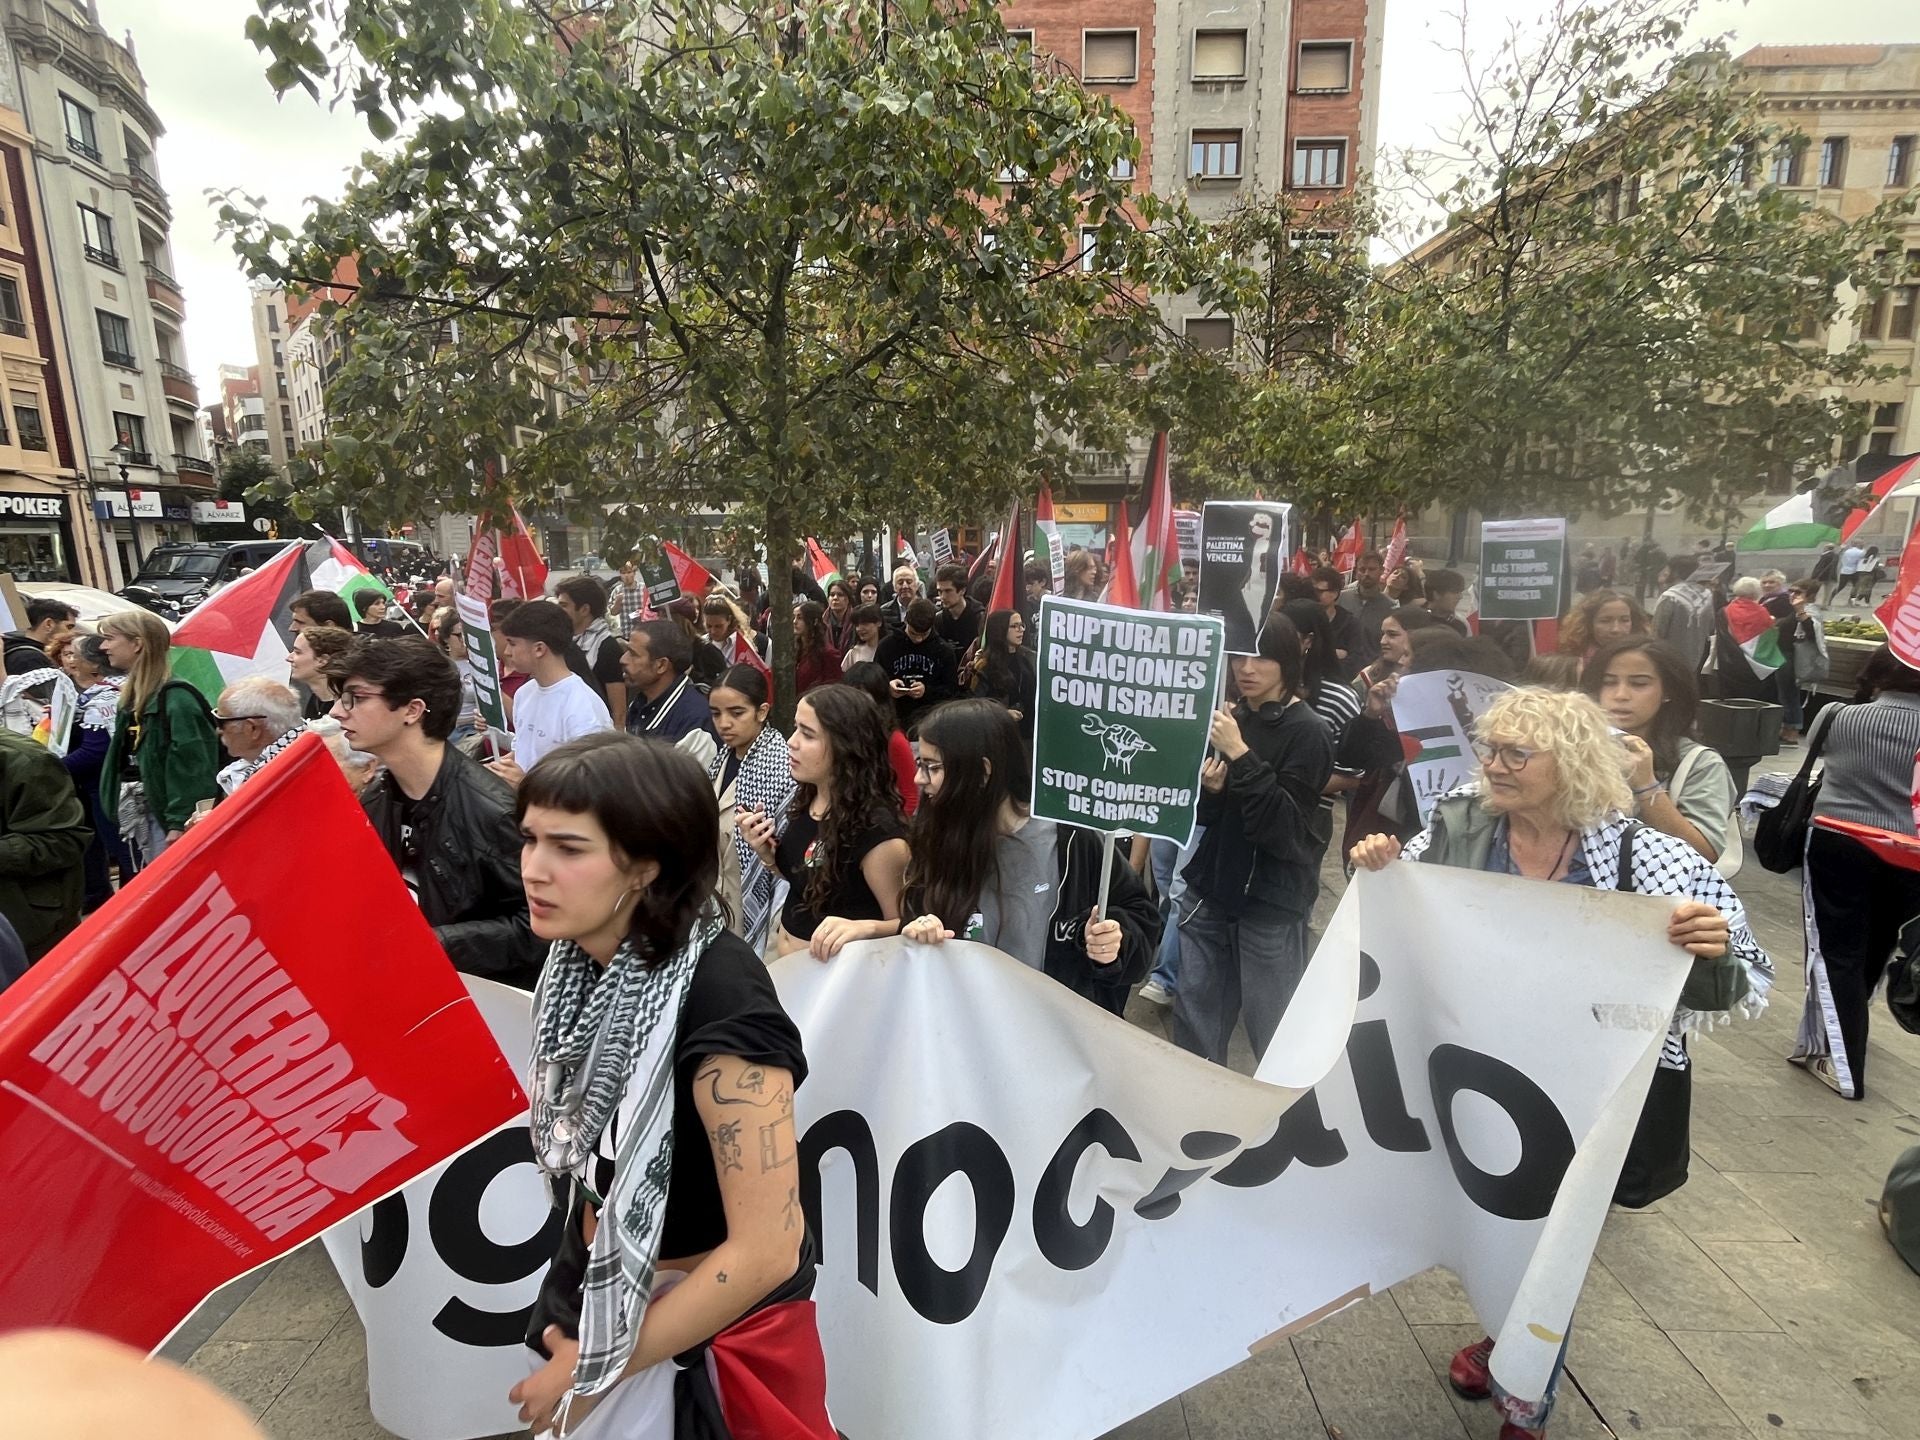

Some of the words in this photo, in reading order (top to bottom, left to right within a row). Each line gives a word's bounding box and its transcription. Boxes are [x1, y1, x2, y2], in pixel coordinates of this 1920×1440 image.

[0, 496, 62, 515] POKER
[1206, 541, 1244, 550] PALESTINA
[1491, 563, 1509, 573] LAS
[1049, 609, 1171, 654] RUPTURA
[1176, 627, 1213, 657] DE
[1048, 643, 1207, 690] RELACIONES
[1051, 675, 1103, 710] CON
[1107, 686, 1197, 720] ISRAEL
[1042, 767, 1088, 792] STOP
[1091, 778, 1191, 807] COMERCIO
[1068, 794, 1091, 814] DE
[1092, 800, 1160, 824] ARMAS
[119, 870, 384, 1150] IZQUIERDA
[28, 968, 336, 1242] REVOLUCIONARIA
